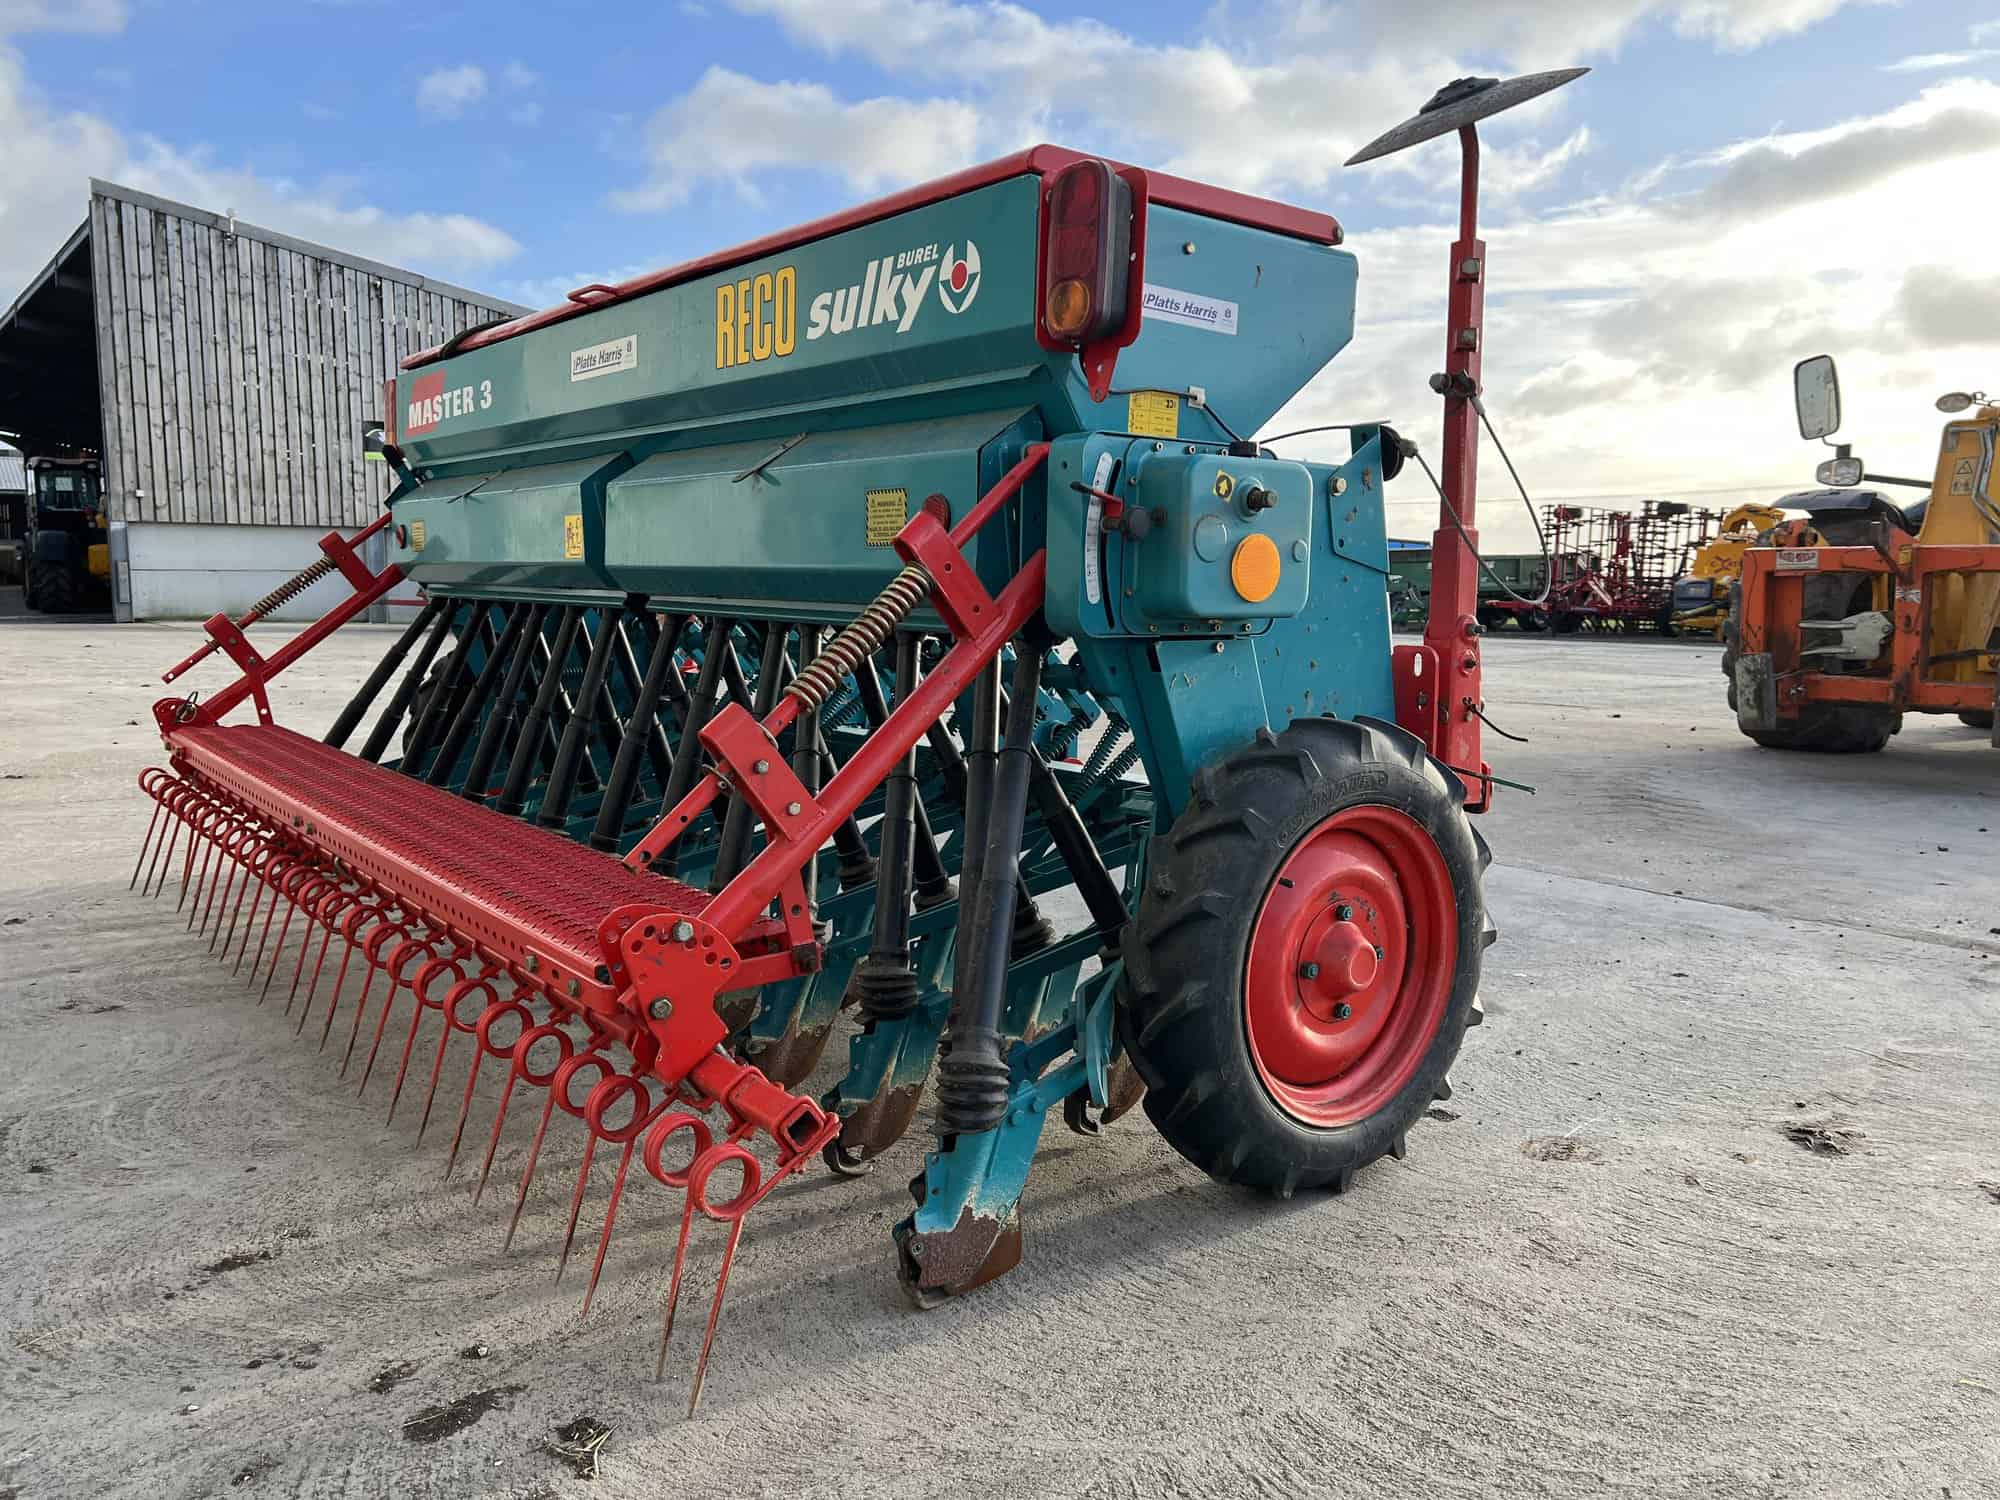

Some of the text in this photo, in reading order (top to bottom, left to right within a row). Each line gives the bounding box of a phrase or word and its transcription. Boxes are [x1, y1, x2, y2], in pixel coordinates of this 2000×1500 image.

[897, 243, 939, 269] BUREL
[715, 264, 797, 369] RECO
[806, 256, 936, 340] sulky
[1146, 293, 1218, 320] Platts Harris
[575, 345, 623, 371] Platts Harris
[408, 379, 492, 429] MASTER 3
